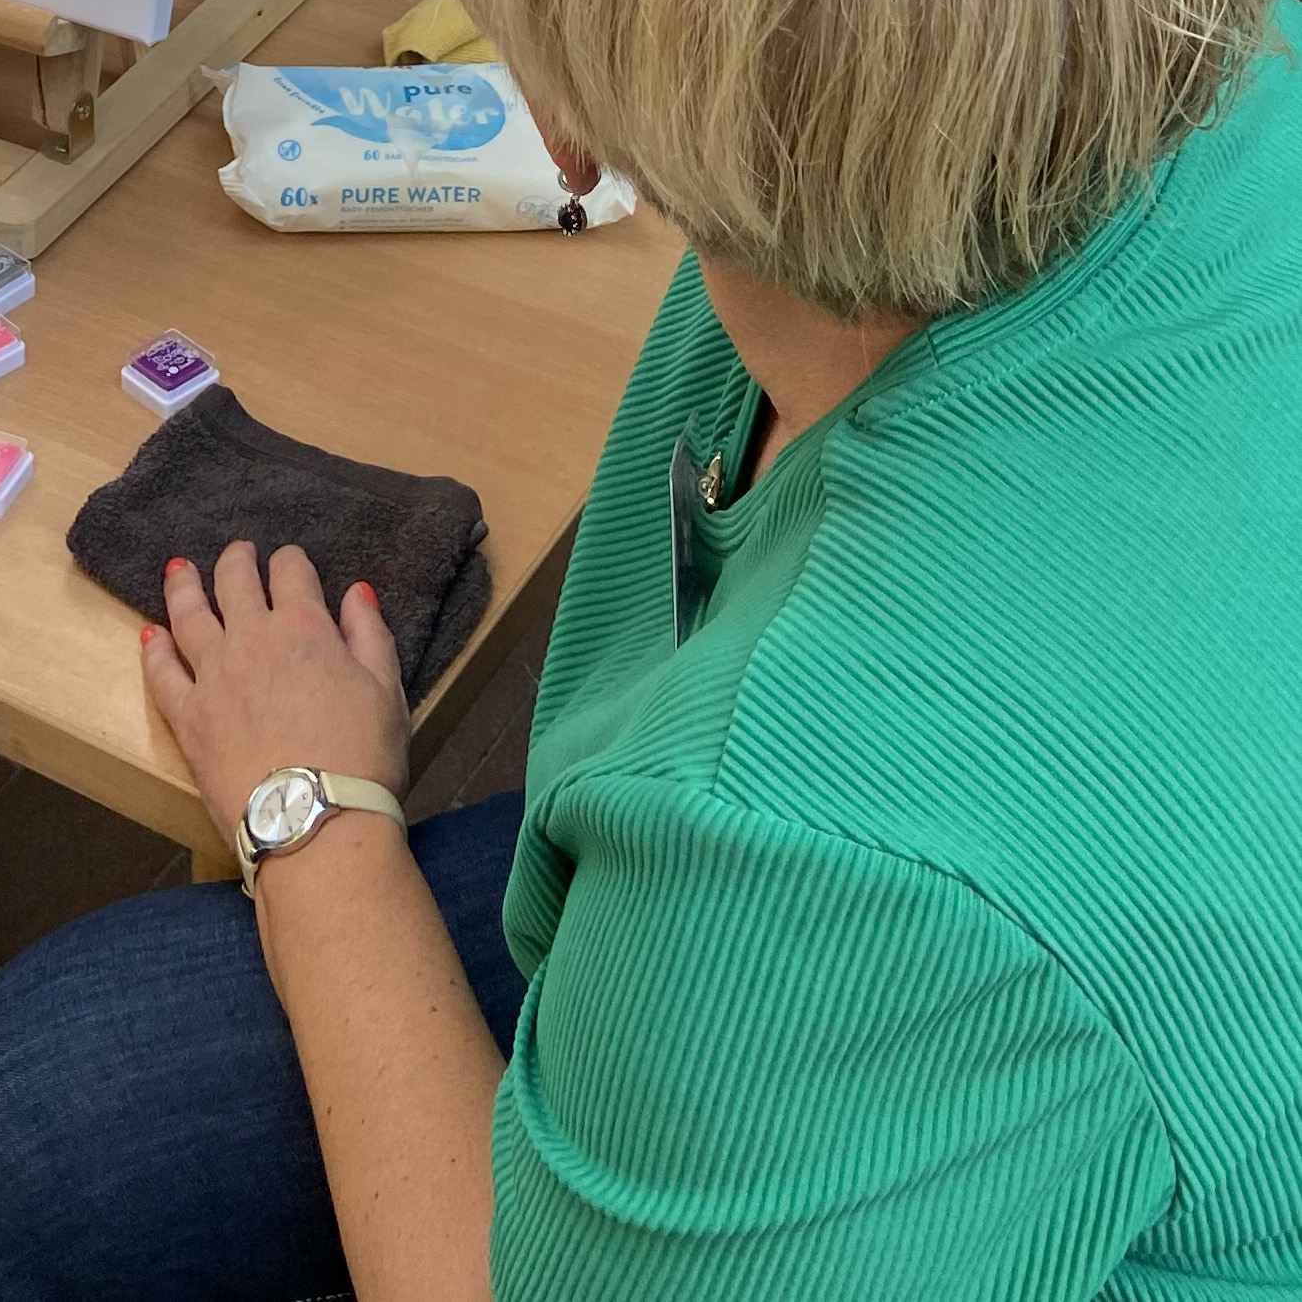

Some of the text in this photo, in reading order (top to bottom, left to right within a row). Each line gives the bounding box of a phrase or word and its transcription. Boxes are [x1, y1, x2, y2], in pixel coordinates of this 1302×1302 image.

[403, 84, 472, 103] pure
[363, 149, 380, 161] 60
[280, 187, 319, 207] 60x
[341, 185, 482, 205] PURE WATER
